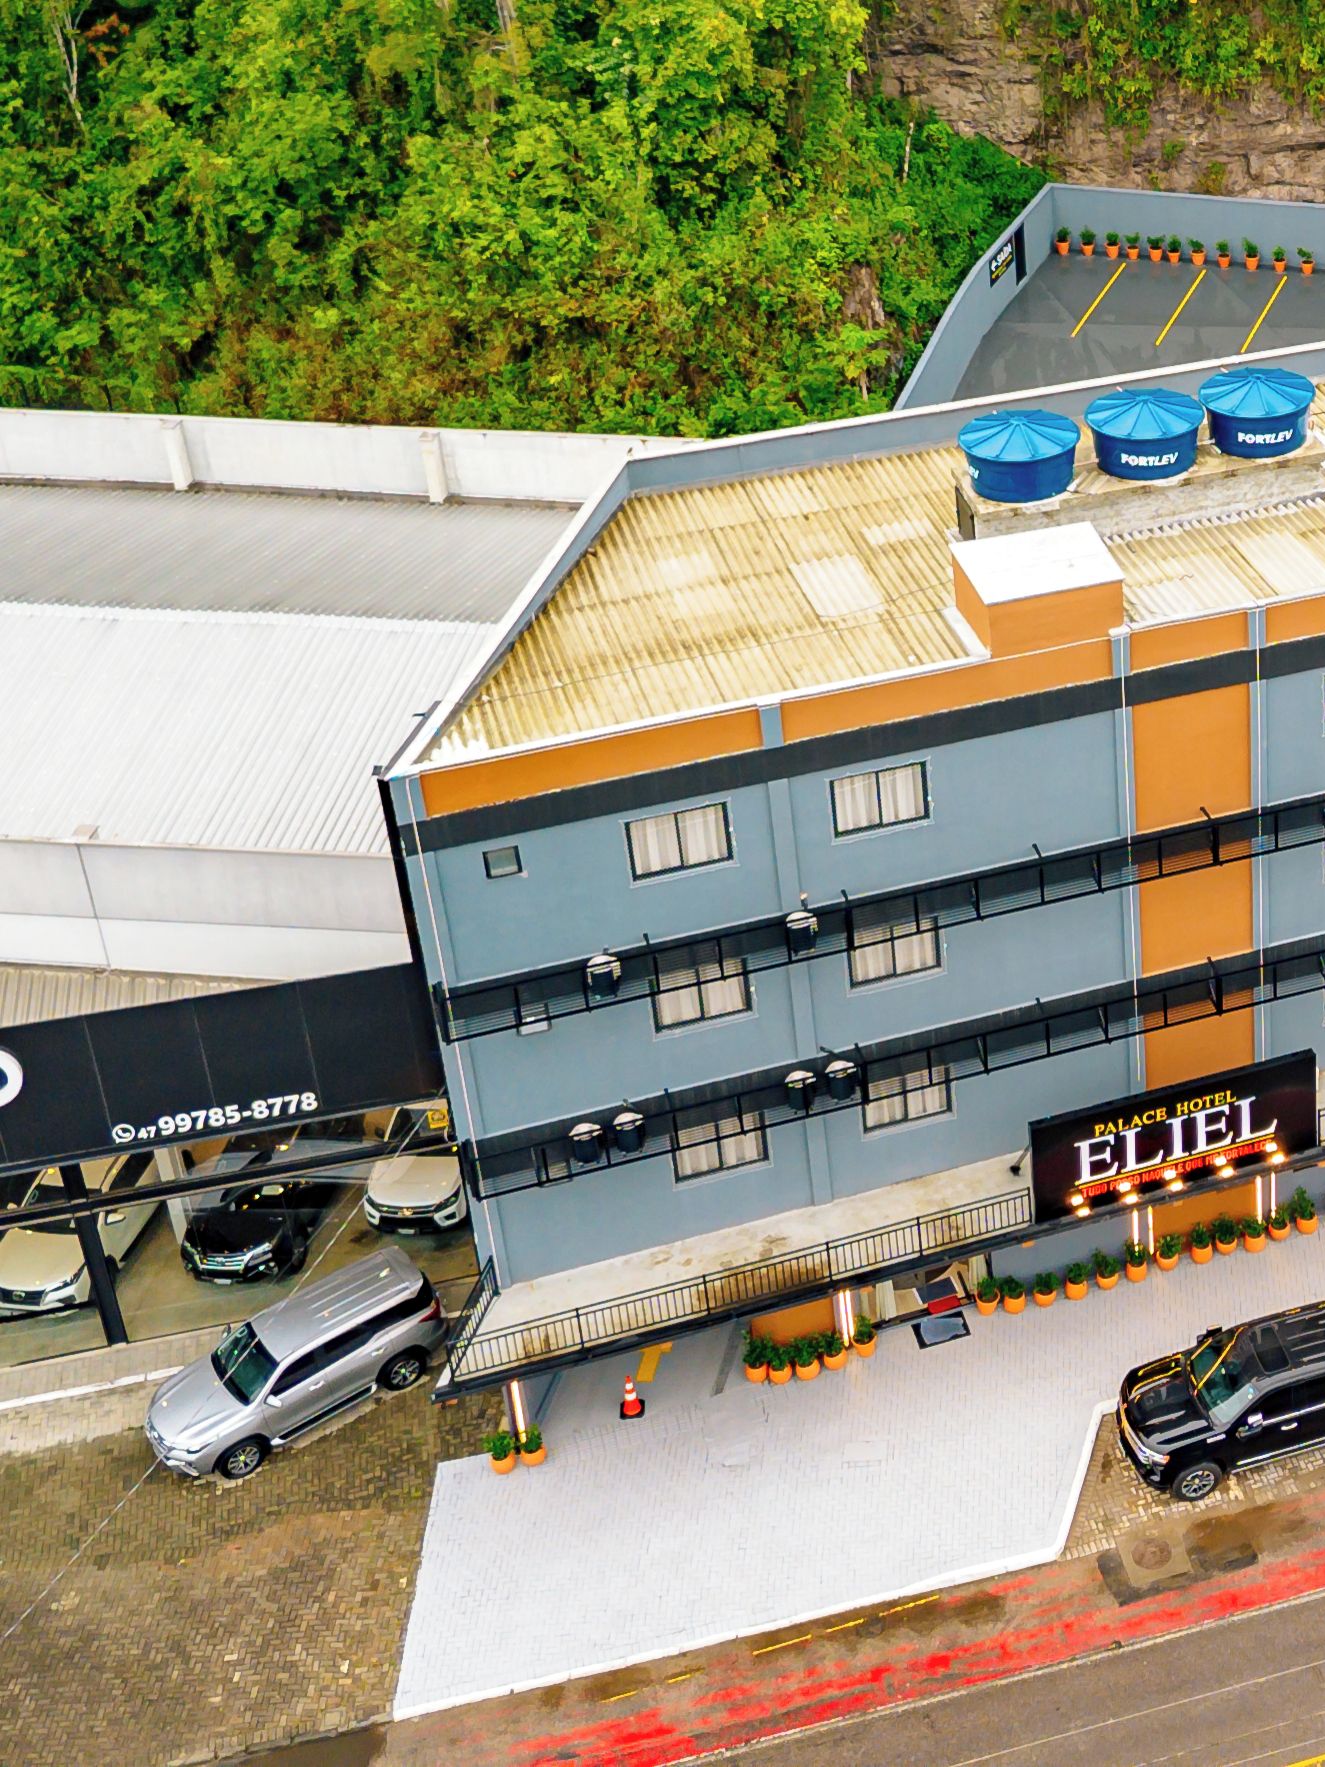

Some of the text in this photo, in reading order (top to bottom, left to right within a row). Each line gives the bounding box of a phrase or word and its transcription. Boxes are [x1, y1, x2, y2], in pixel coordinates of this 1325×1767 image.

[1237, 429, 1293, 444] FORTLEV
[1120, 452, 1179, 467] FORTLEV
[137, 1092, 319, 1140] 47 99785-8778
[1094, 1090, 1237, 1138] PALACE HOTEL
[1073, 1096, 1278, 1186] ELIEL
[1082, 1183, 1108, 1198] TUDO
